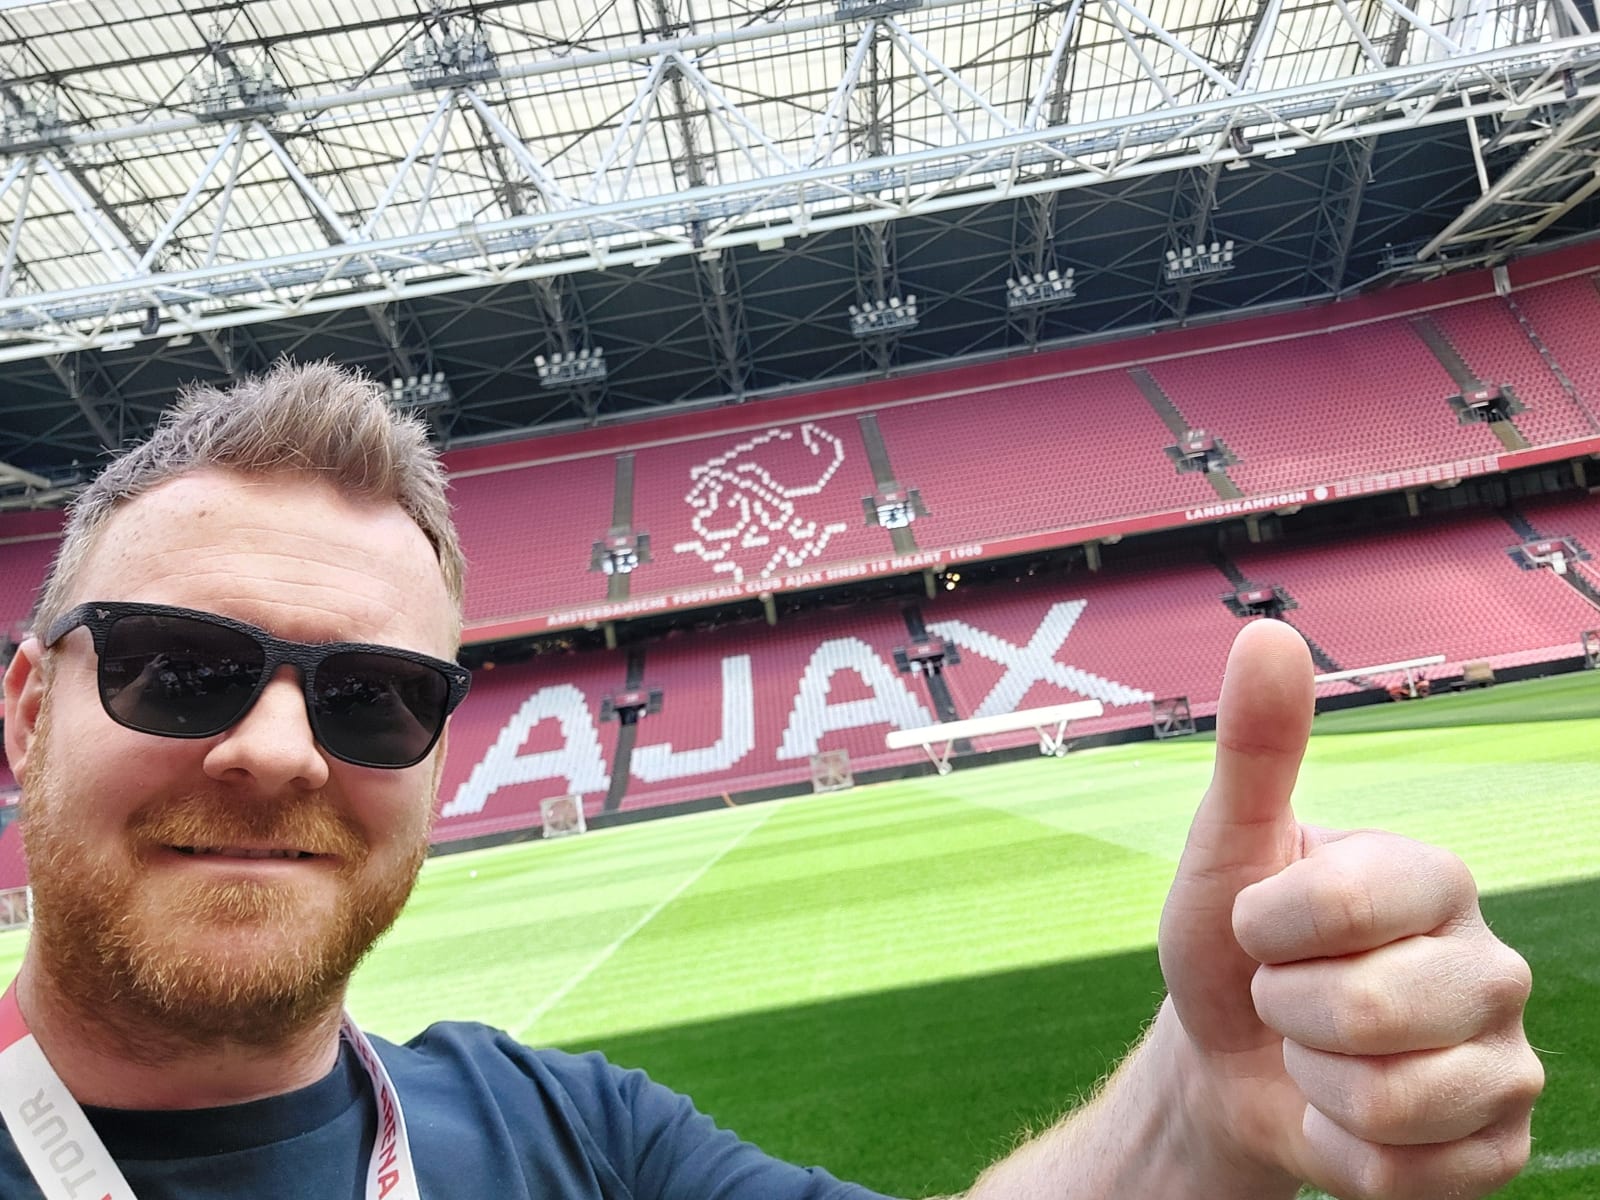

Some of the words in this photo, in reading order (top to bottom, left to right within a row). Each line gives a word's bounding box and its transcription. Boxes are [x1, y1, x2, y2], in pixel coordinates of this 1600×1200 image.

[1185, 491, 1307, 520] LANDSKAMPIOEN
[672, 586, 742, 605] FOOTBALL
[745, 577, 781, 593] CLUB
[786, 572, 822, 587] AJAX
[826, 563, 867, 579] SINDS
[891, 551, 942, 569] MAART
[949, 544, 983, 560] 1900
[442, 598, 1154, 818] AJAX
[18, 1087, 97, 1200] TOUR
[378, 1083, 400, 1200] ARENA
